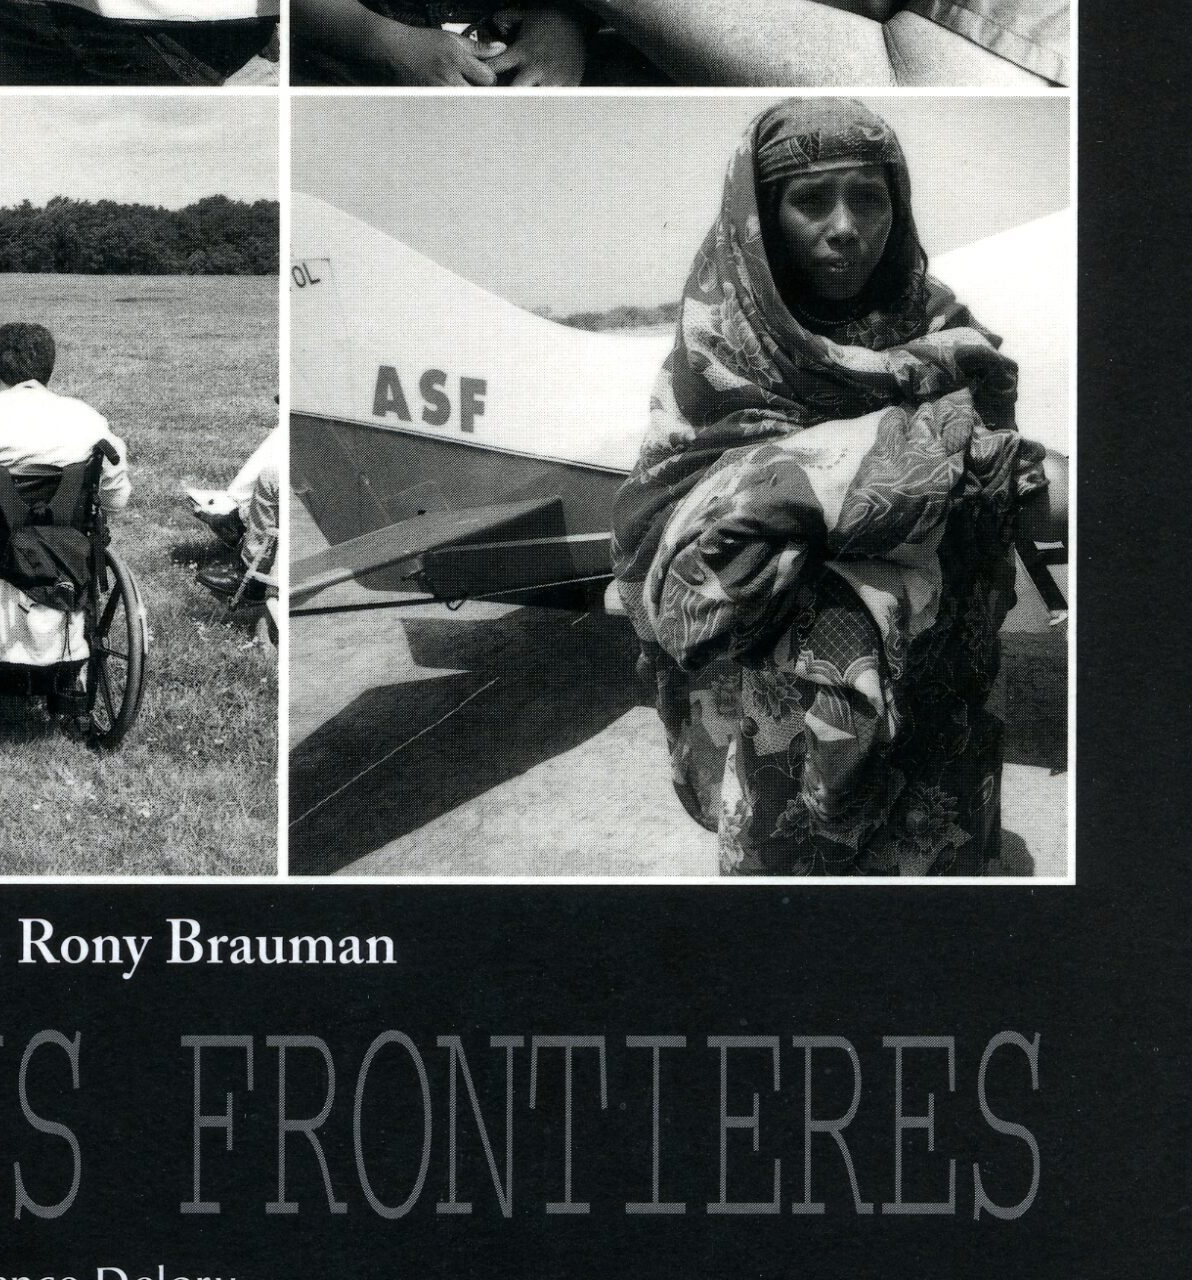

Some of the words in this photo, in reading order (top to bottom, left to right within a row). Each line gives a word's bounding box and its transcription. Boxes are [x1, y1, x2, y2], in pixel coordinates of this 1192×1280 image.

[372, 365, 487, 433] ASF
[19, 919, 151, 979] Rony
[167, 919, 396, 964] Brauman
[181, 1030, 1041, 1220] FRONTIERES
